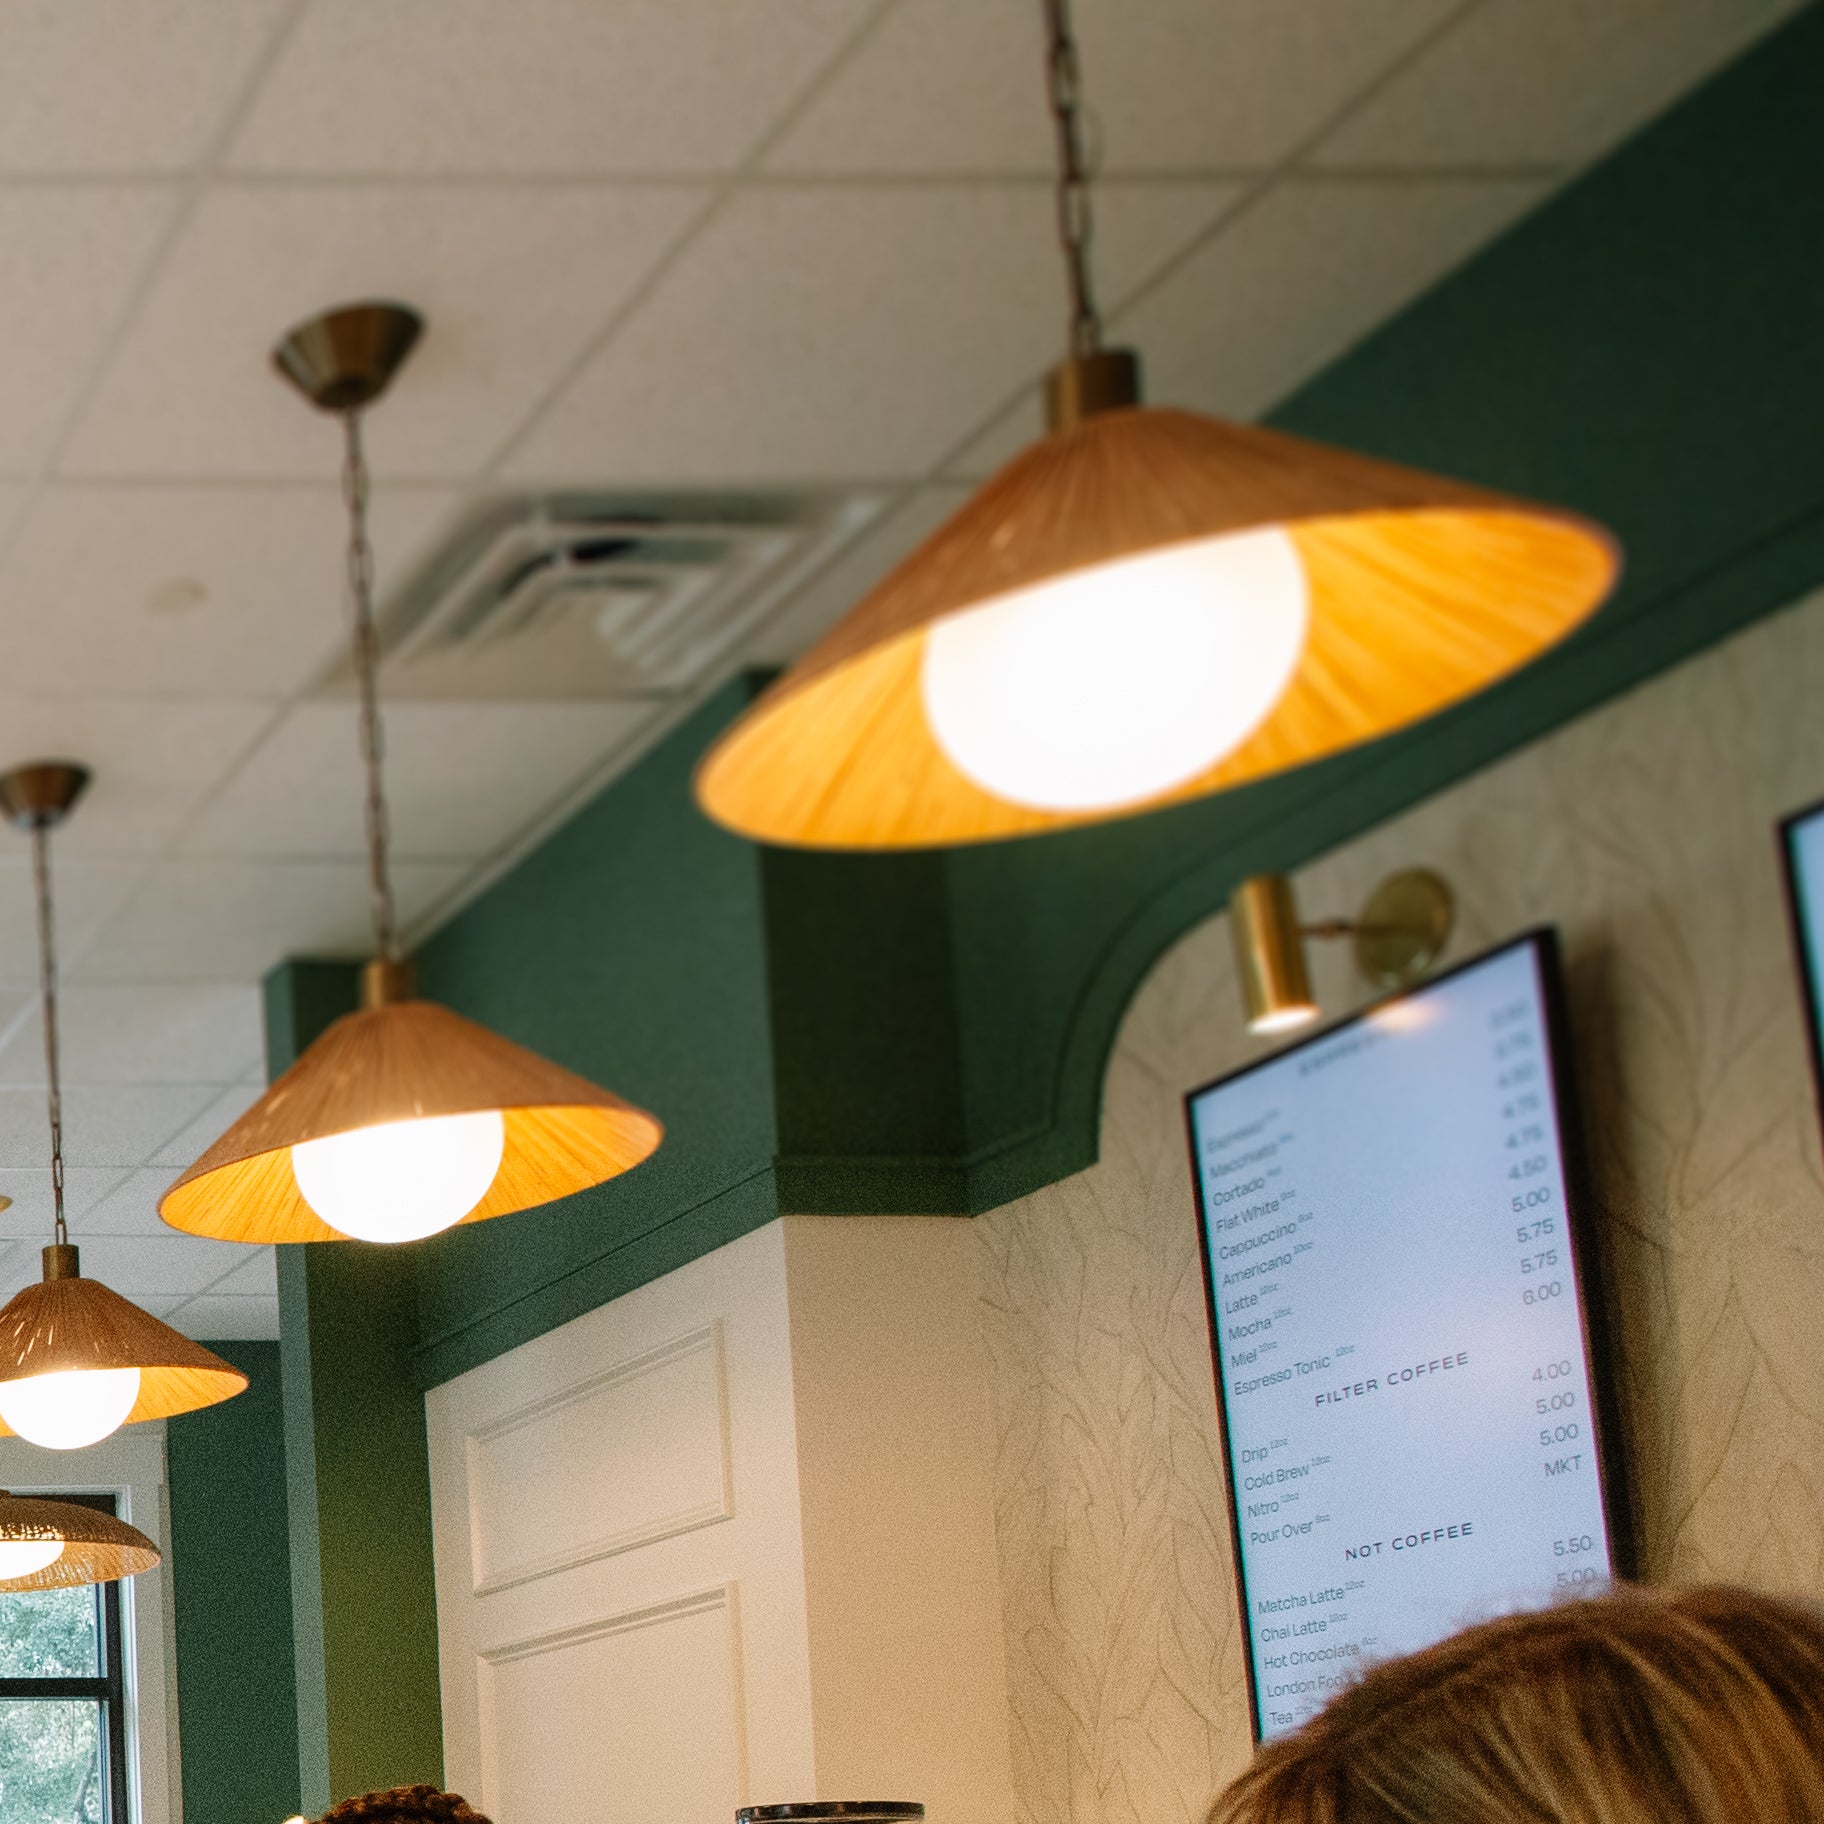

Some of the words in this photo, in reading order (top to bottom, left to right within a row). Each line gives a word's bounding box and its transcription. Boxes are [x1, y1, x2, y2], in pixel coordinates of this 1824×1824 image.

[1508, 1155, 1549, 1180] 4.50
[1213, 1177, 1265, 1207] Cortado
[1511, 1187, 1551, 1213] 5.00
[1216, 1214, 1240, 1232] Flat
[1242, 1198, 1280, 1223] White
[1219, 1222, 1297, 1260] Cappuccino
[1516, 1218, 1555, 1243] 5.75
[1222, 1252, 1293, 1287] Americano
[1520, 1250, 1558, 1274] 5.75
[1225, 1293, 1258, 1314] Latte
[1522, 1281, 1562, 1305] 6.00
[1228, 1318, 1272, 1341] Mocha
[1231, 1348, 1258, 1368] Miel
[1234, 1368, 1292, 1396] Espresso
[1293, 1356, 1331, 1376] Tonic
[1314, 1378, 1378, 1407] FILTER
[1387, 1352, 1469, 1386] COFFEE
[1532, 1360, 1571, 1382] 4.00
[1536, 1391, 1575, 1414] 5.00
[1540, 1423, 1579, 1446] 5.00
[1241, 1445, 1269, 1464] Drip
[1544, 1455, 1582, 1477] MKT
[1244, 1471, 1274, 1491] Cold
[1276, 1464, 1310, 1483] Brew
[1248, 1500, 1279, 1518] Nitro
[1251, 1529, 1279, 1545] Pour
[1282, 1521, 1313, 1538] Over
[1345, 1541, 1383, 1561] NOT
[1392, 1522, 1474, 1551] COFFEE
[1553, 1535, 1592, 1557] 5.50
[1556, 1567, 1596, 1588] 5.00
[1258, 1594, 1307, 1614] Matcha
[1309, 1587, 1345, 1604] Latte
[1260, 1625, 1290, 1642] Chai
[1293, 1619, 1327, 1637] Latte
[1264, 1655, 1288, 1670] Hot
[1289, 1643, 1360, 1666] Chocolate
[1267, 1676, 1316, 1698] London
[1269, 1711, 1293, 1726] Tea
